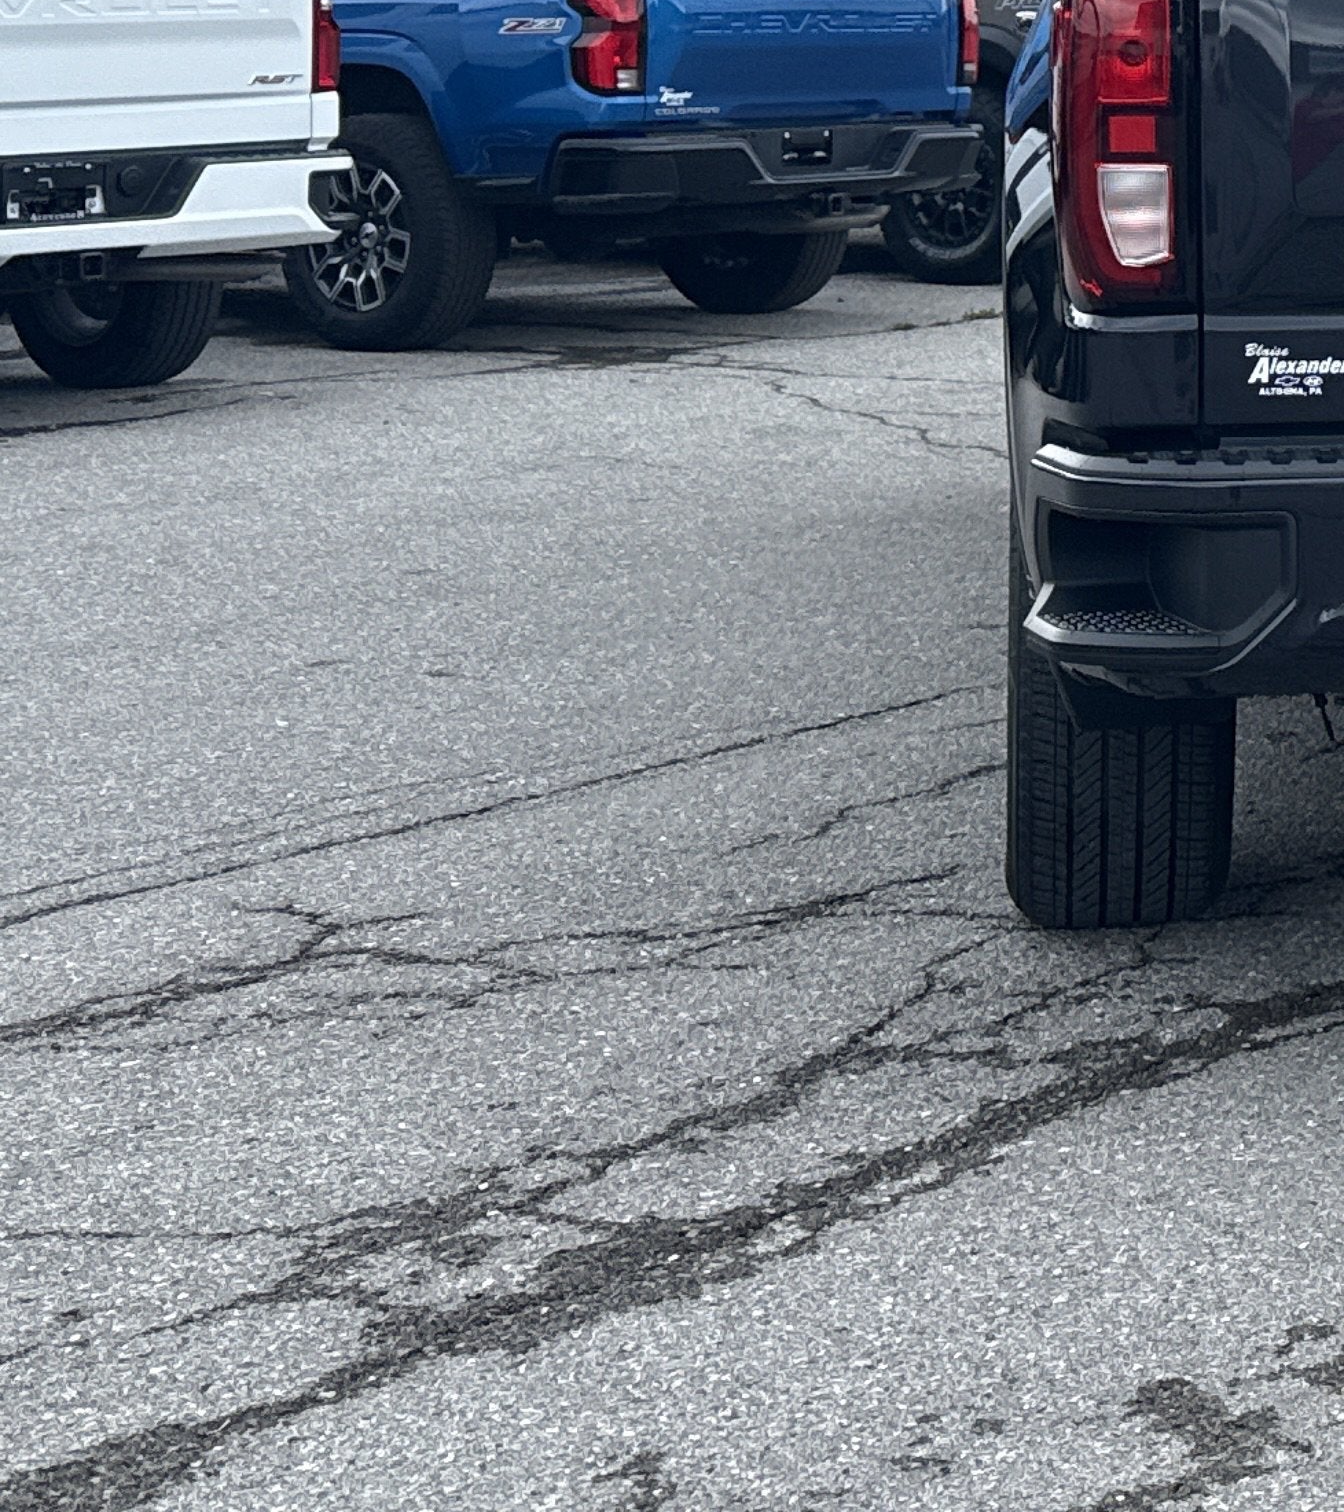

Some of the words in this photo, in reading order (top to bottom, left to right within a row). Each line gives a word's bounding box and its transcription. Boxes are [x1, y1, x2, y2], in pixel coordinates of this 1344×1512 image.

[693, 13, 937, 34] CHEVROLET
[248, 74, 304, 86] RST
[1245, 342, 1290, 357] Blaise
[1309, 387, 1323, 396] PA
